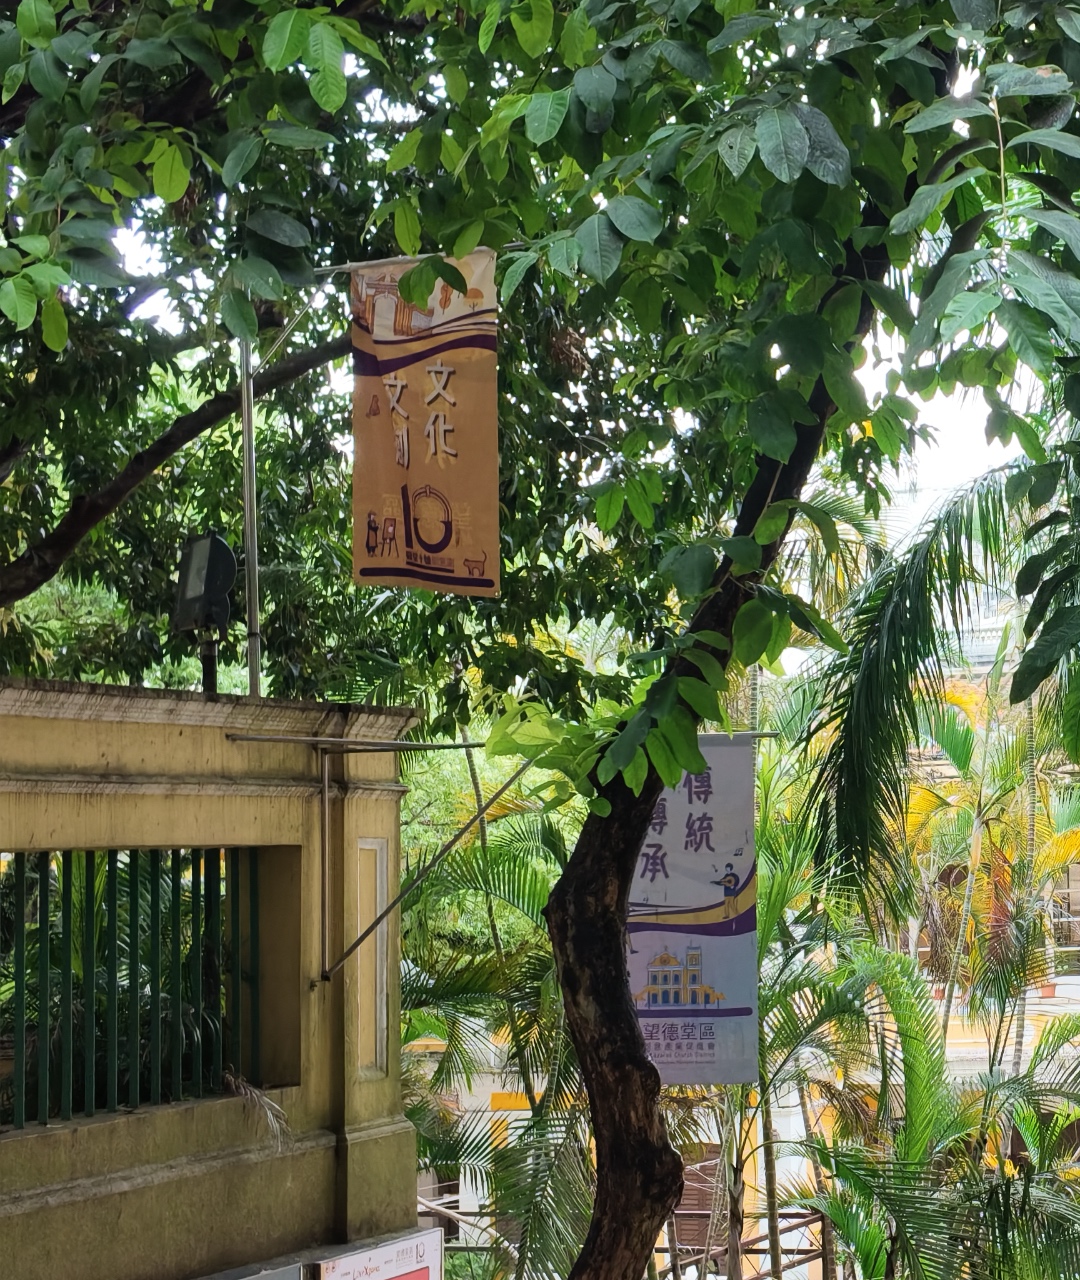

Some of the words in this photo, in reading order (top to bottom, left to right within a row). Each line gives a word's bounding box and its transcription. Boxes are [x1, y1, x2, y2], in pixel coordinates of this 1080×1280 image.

[424, 359, 458, 458] 文化
[682, 766, 715, 853] 傳統
[643, 1022, 716, 1041] 望德堂區
